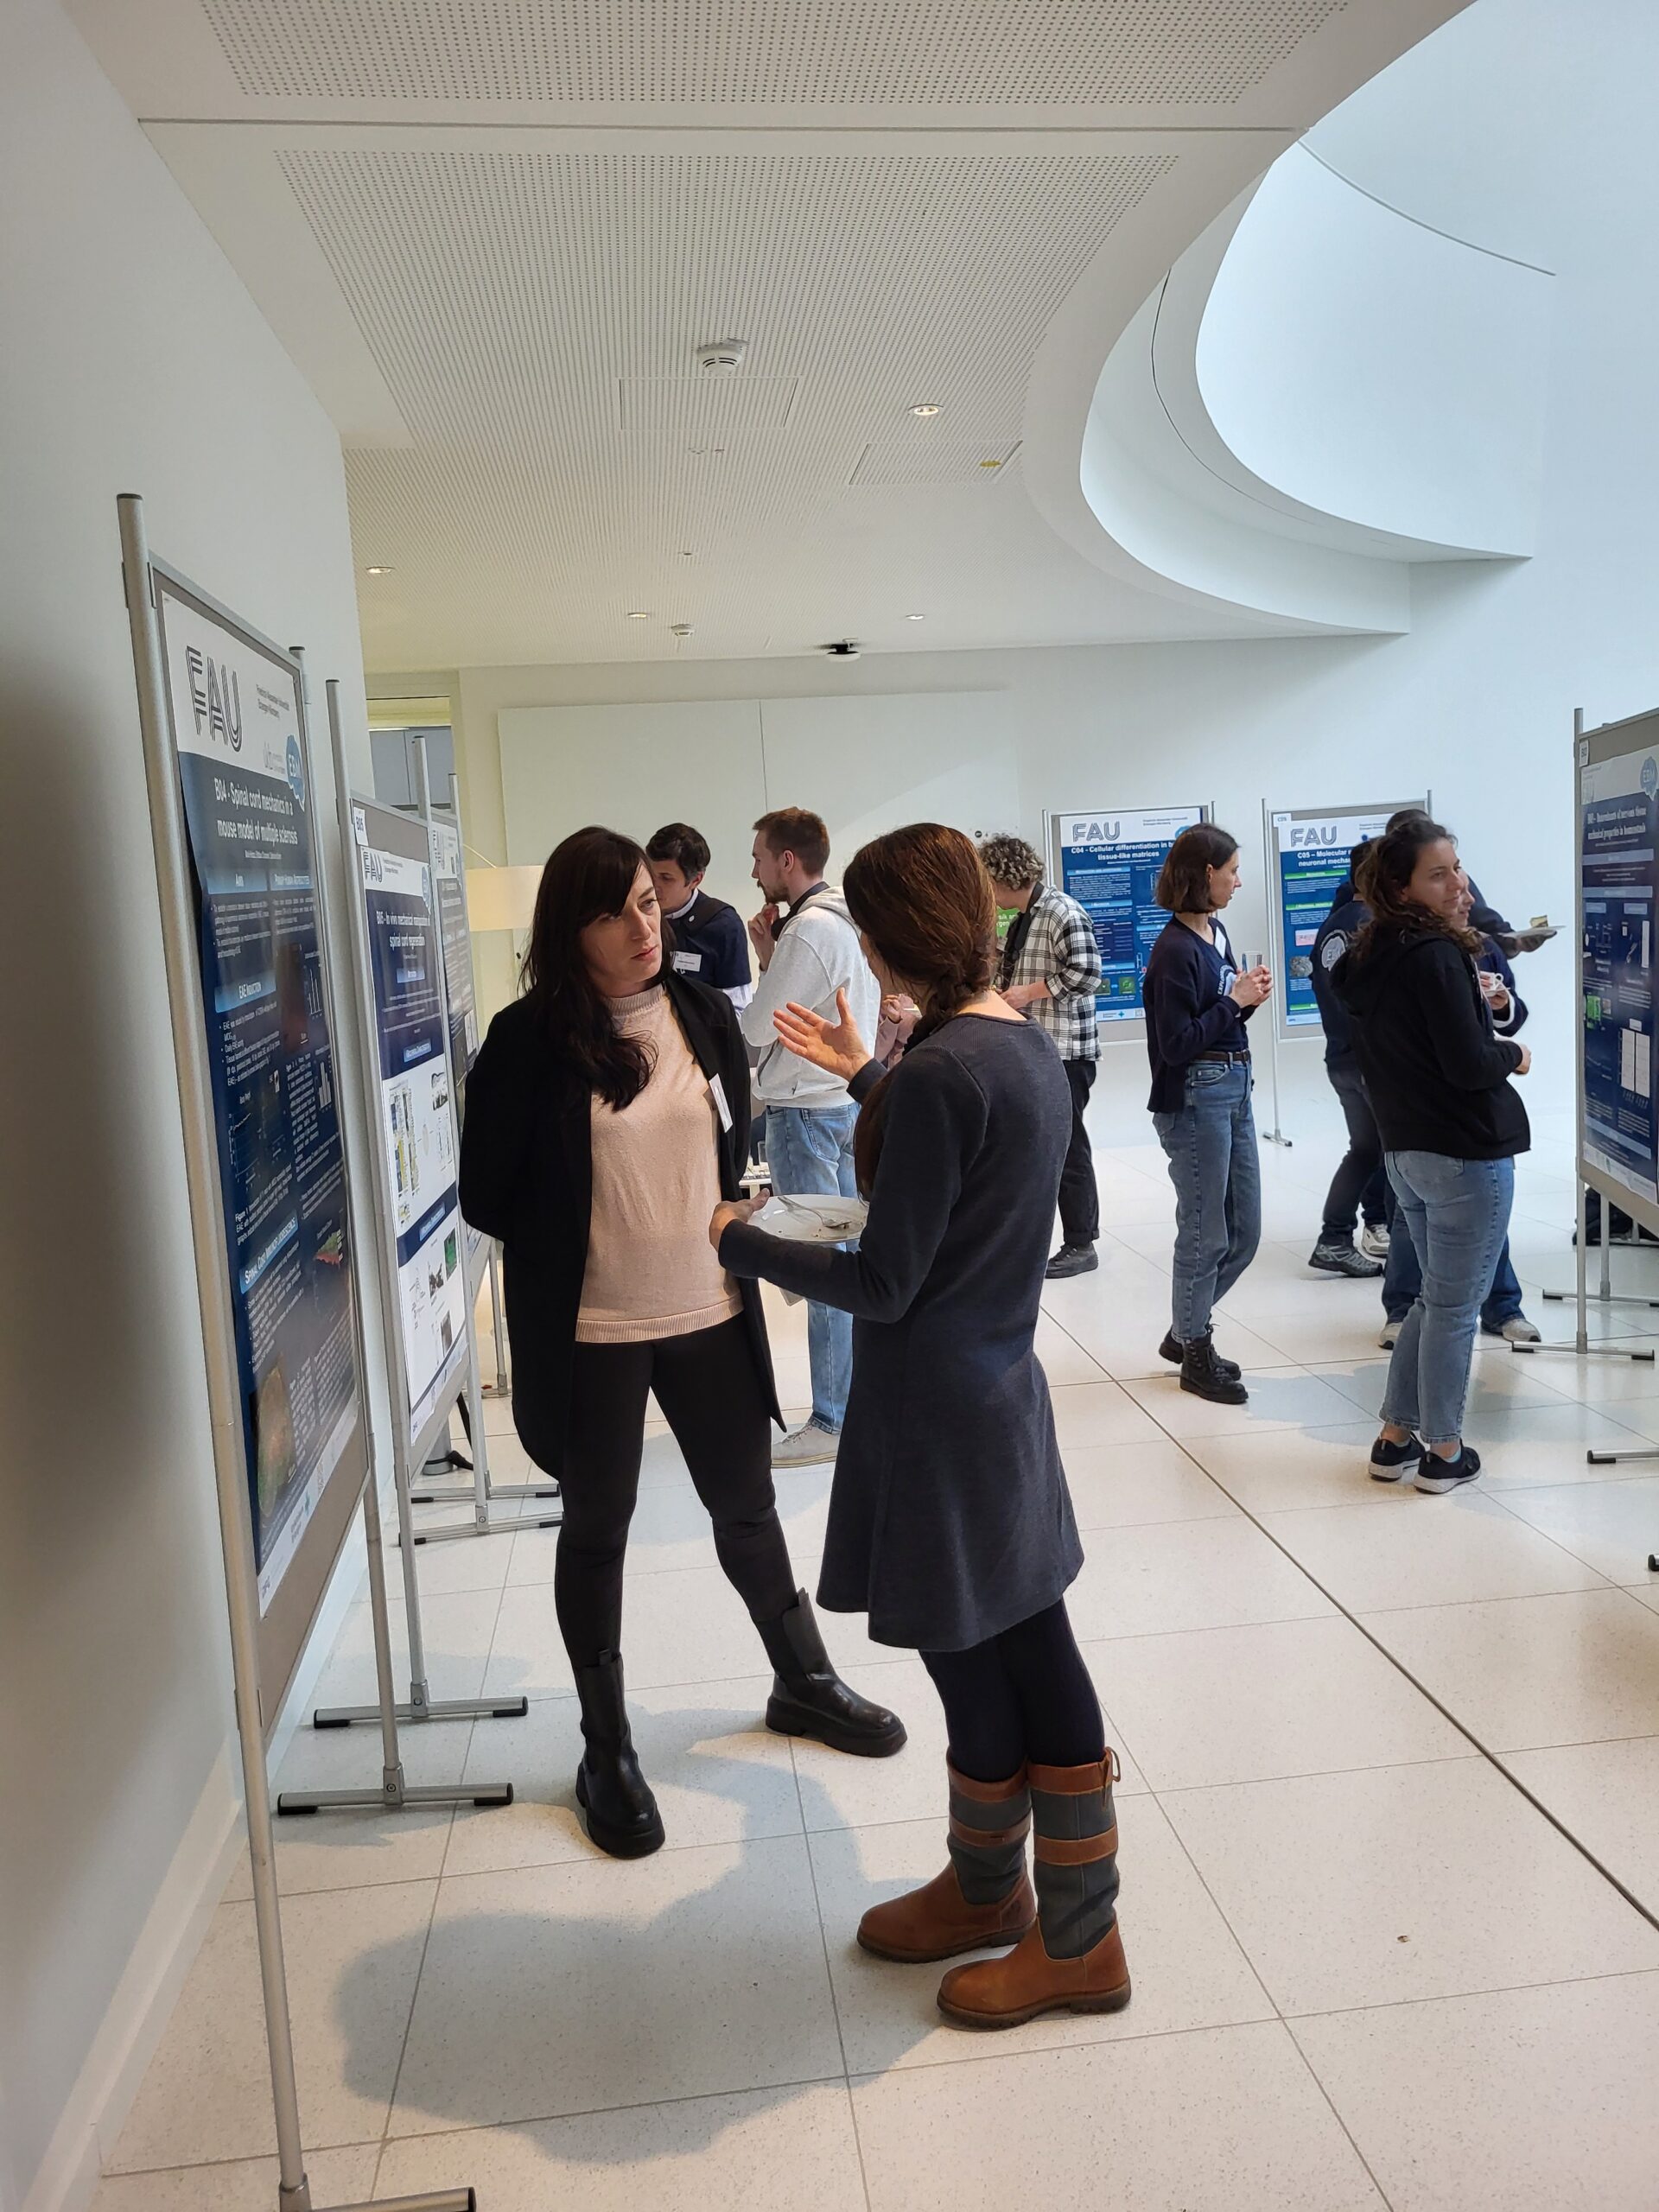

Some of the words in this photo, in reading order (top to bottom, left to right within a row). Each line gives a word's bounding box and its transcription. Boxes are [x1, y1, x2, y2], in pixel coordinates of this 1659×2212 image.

[185, 645, 243, 753] FAU
[214, 777, 227, 802] B04
[230, 782, 250, 810] Spinal
[249, 789, 262, 810] cord
[217, 819, 238, 839] mouse
[237, 818, 255, 840] model
[254, 819, 261, 841] of
[1072, 821, 1121, 842] FAU
[1290, 826, 1337, 848] FAU
[1089, 844, 1114, 853] Cellular
[1115, 842, 1160, 851] differentiation
[1097, 852, 1131, 861] tissue-like
[1131, 850, 1160, 859] matrices
[1316, 849, 1347, 858] Molecular
[363, 850, 383, 883] FAU
[1298, 858, 1326, 868] neuronal
